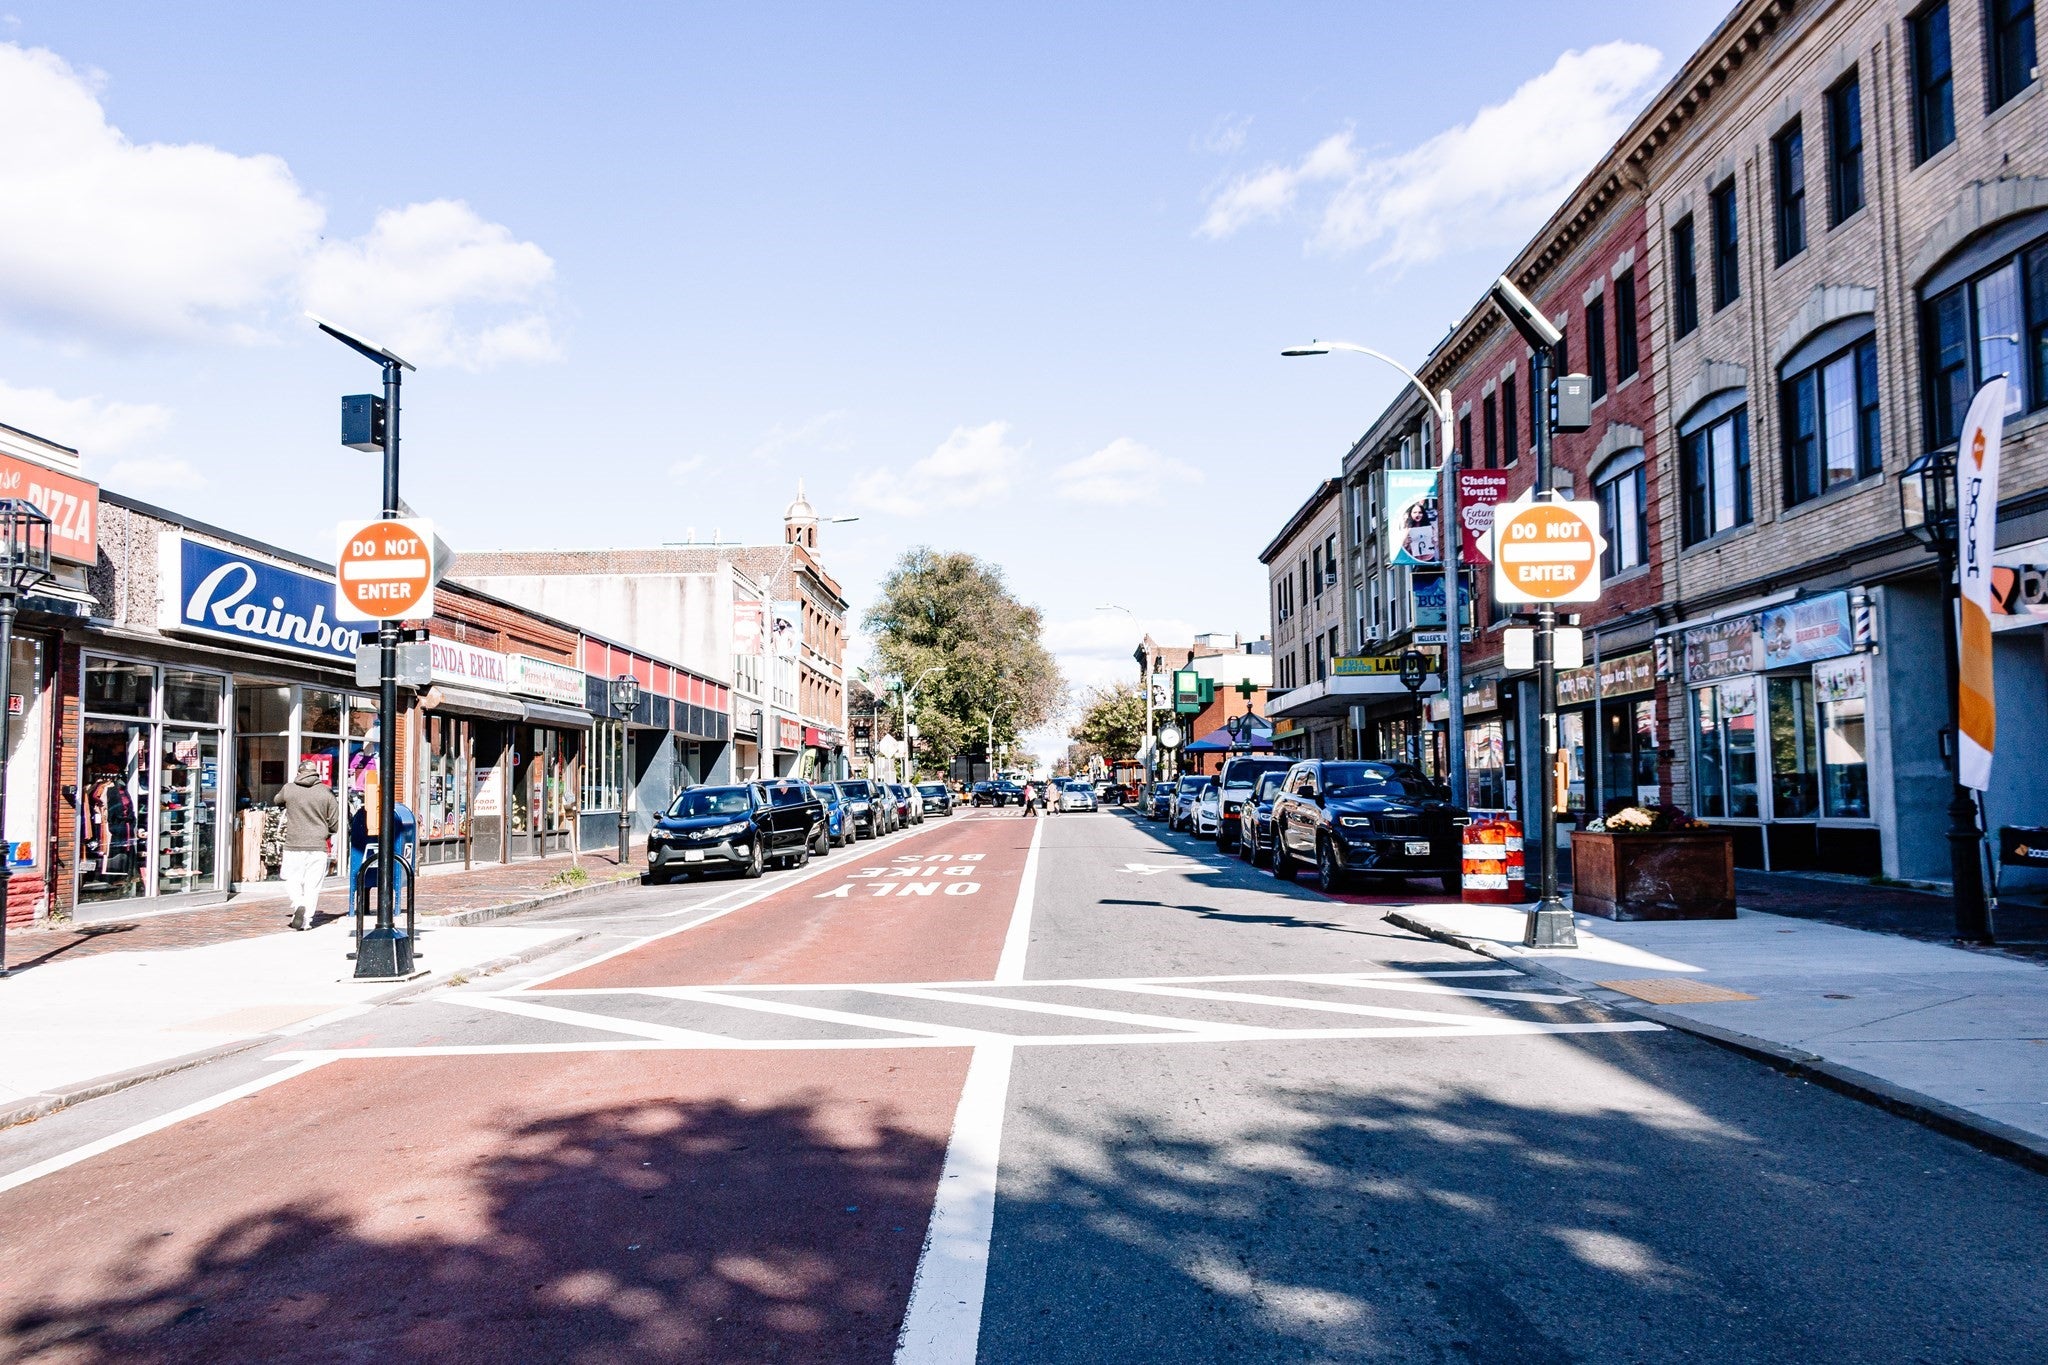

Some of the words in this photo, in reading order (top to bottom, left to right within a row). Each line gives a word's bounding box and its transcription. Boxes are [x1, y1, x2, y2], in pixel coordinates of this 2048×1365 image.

[0, 468, 20, 489] se
[1461, 476, 1506, 485] Chelsea
[1462, 486, 1498, 496] Youth
[1511, 523, 1537, 540] DO
[1545, 522, 1582, 539] NOT
[1967, 477, 1982, 579] boost
[352, 540, 376, 557] DO
[384, 538, 418, 556] NOT
[1518, 564, 1576, 582] ENTER
[357, 582, 412, 600] ENTER
[1417, 594, 1467, 608] BUSH
[420, 641, 466, 674] ENDA
[469, 653, 504, 682] ERIKA
[1342, 659, 1365, 667] FULL
[1376, 658, 1433, 672] LAUDY
[317, 759, 330, 781] LE
[891, 853, 986, 863] BUS
[846, 865, 976, 878] BIKE
[812, 881, 982, 898] ONLY
